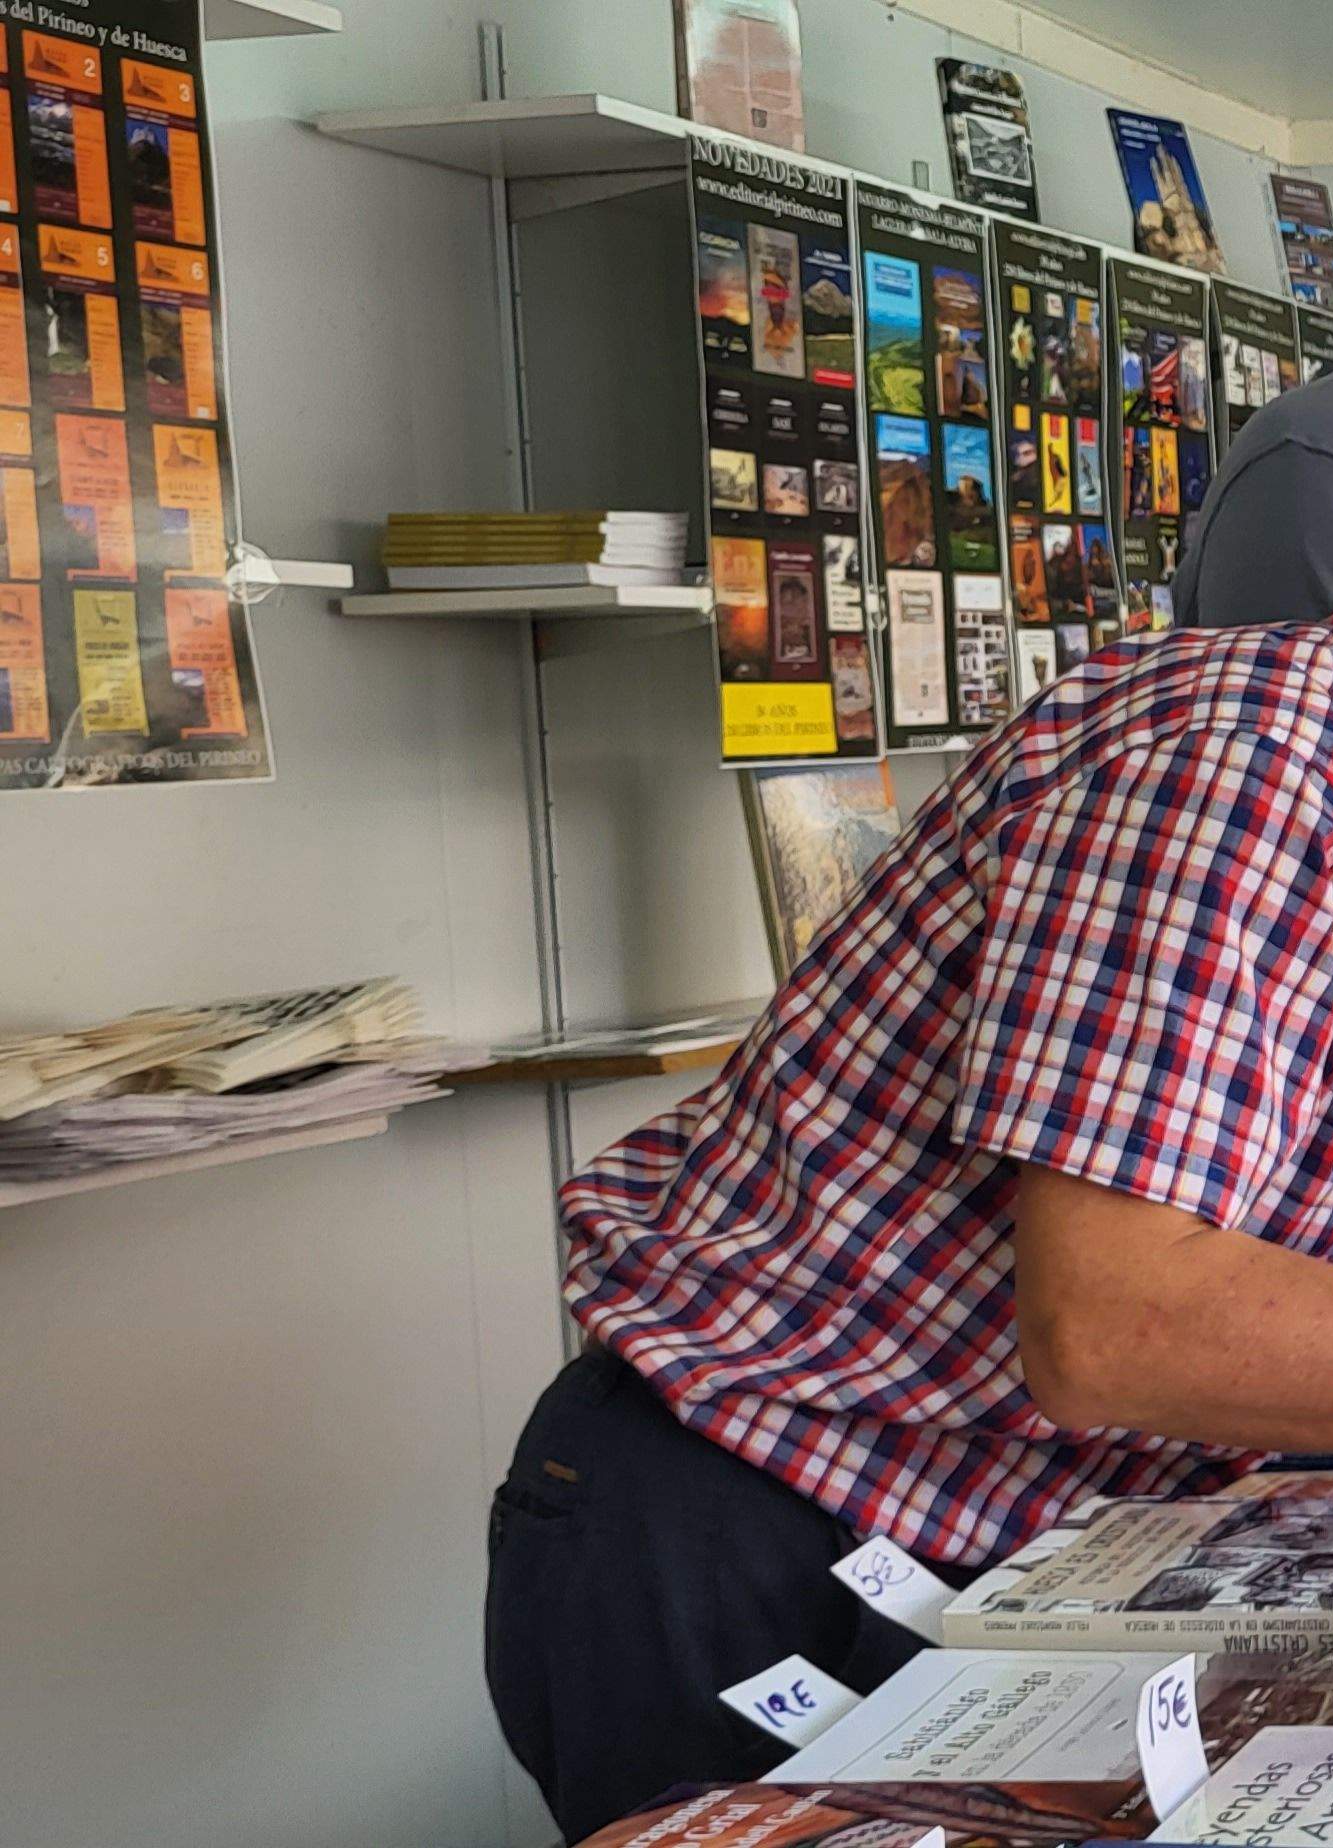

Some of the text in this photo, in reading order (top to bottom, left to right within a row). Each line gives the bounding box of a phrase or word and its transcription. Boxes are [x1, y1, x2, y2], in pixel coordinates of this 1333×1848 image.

[10, 1, 188, 62] del Pirineo y de Huesca
[84, 57, 97, 78] 2
[178, 83, 191, 103] 3
[692, 135, 804, 190] NOVEDADES
[1, 237, 12, 257] 4
[97, 246, 109, 267] 5
[191, 261, 204, 281] 6
[167, 751, 197, 769] DEL
[1223, 1634, 1310, 1651] CRISTIANA
[945, 1722, 996, 1750] Alto
[981, 1670, 1053, 1721] Gállego
[1149, 1675, 1191, 1747] 15€
[884, 1687, 990, 1761] Sabiñánigo
[1196, 1761, 1294, 1845] eyendas
